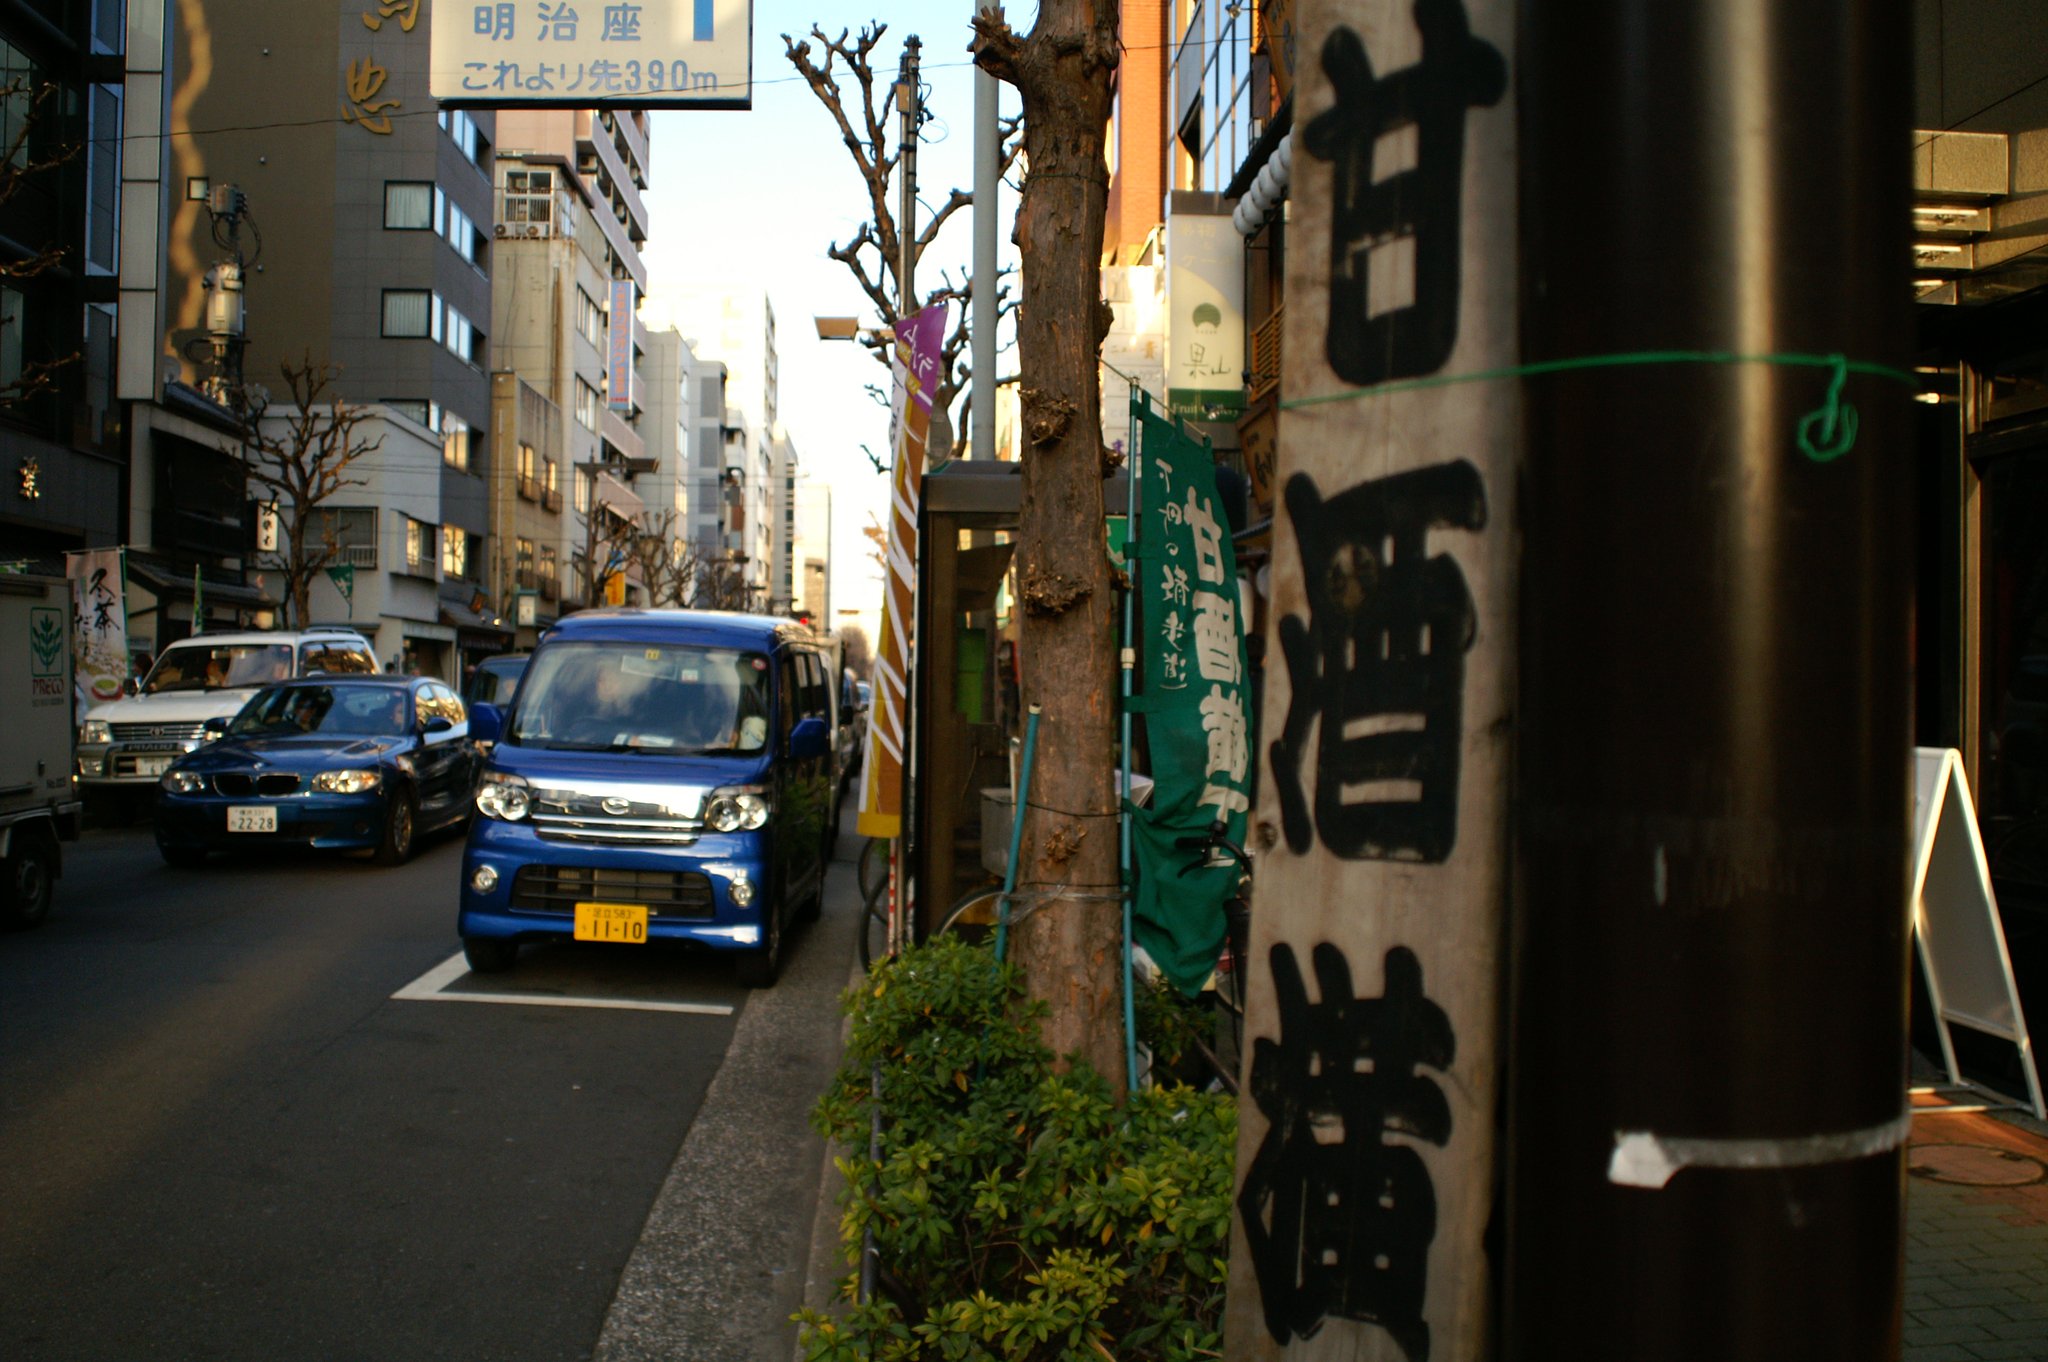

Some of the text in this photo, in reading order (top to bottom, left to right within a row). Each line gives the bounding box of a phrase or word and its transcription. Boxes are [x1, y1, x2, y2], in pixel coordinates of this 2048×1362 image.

[474, 2, 641, 41] 明治座
[462, 60, 717, 92] これより先390m
[1182, 343, 1231, 379] 果山
[237, 817, 274, 830] 22-28
[593, 920, 643, 939] 11-10
